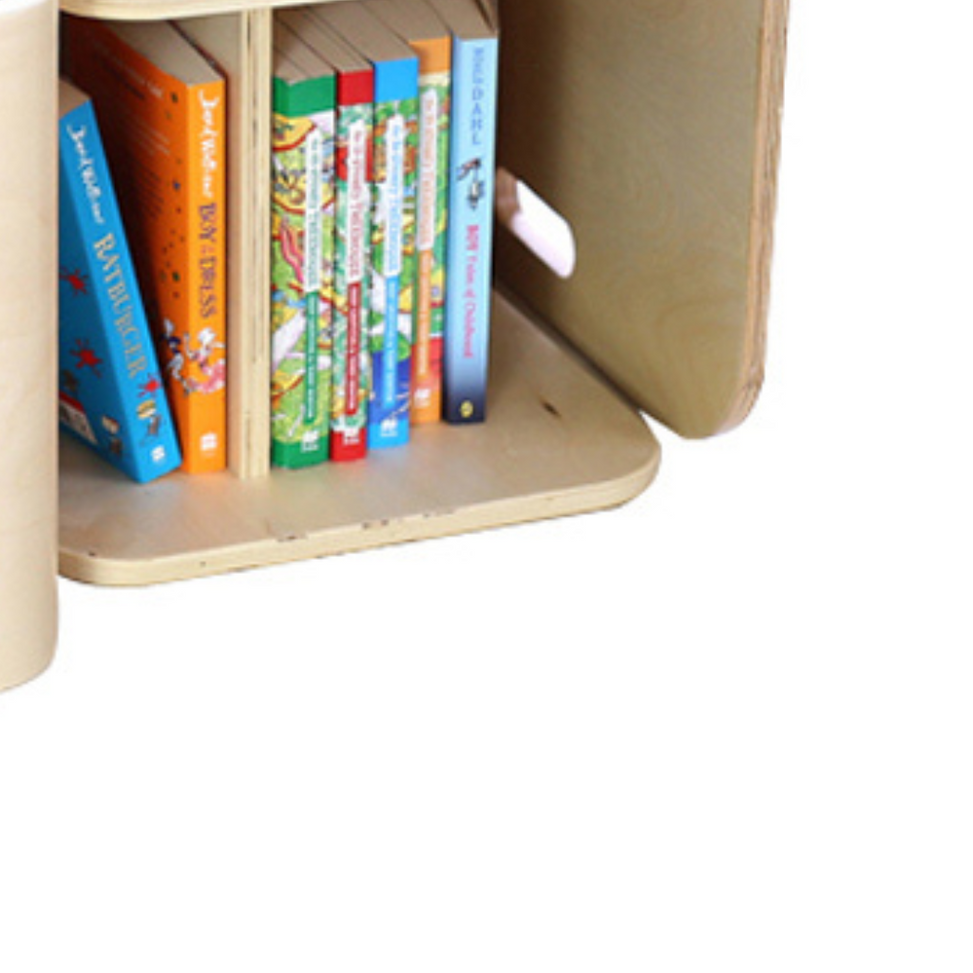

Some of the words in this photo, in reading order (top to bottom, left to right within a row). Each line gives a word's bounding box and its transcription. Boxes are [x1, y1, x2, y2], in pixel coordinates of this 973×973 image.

[472, 88, 483, 145] DAHL
[465, 225, 480, 251] BOY
[93, 232, 149, 379] RATBURGER
[198, 258, 218, 319] DRESS
